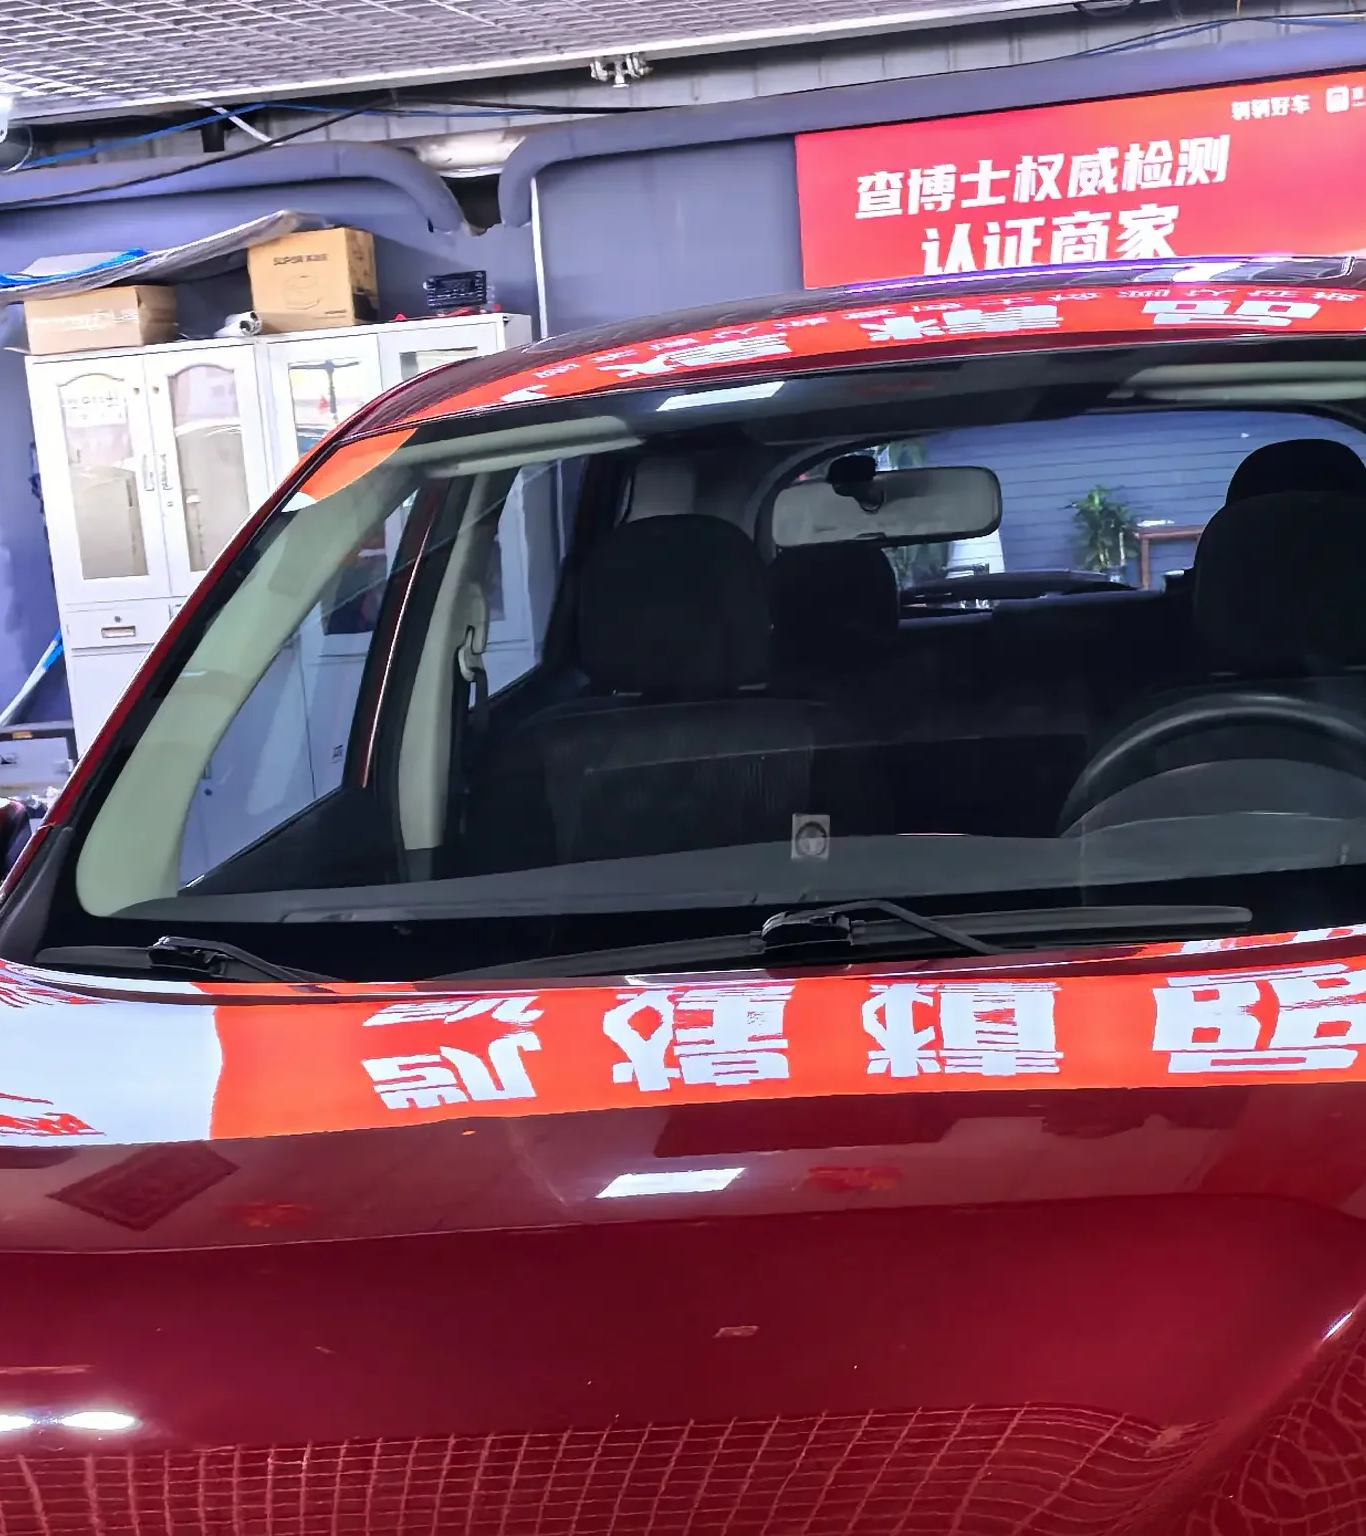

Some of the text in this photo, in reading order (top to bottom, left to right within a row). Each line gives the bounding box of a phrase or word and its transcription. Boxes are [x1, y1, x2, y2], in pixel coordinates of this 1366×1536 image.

[854, 134, 1231, 219] 查博士权威检测
[921, 203, 1180, 276] 认证商家
